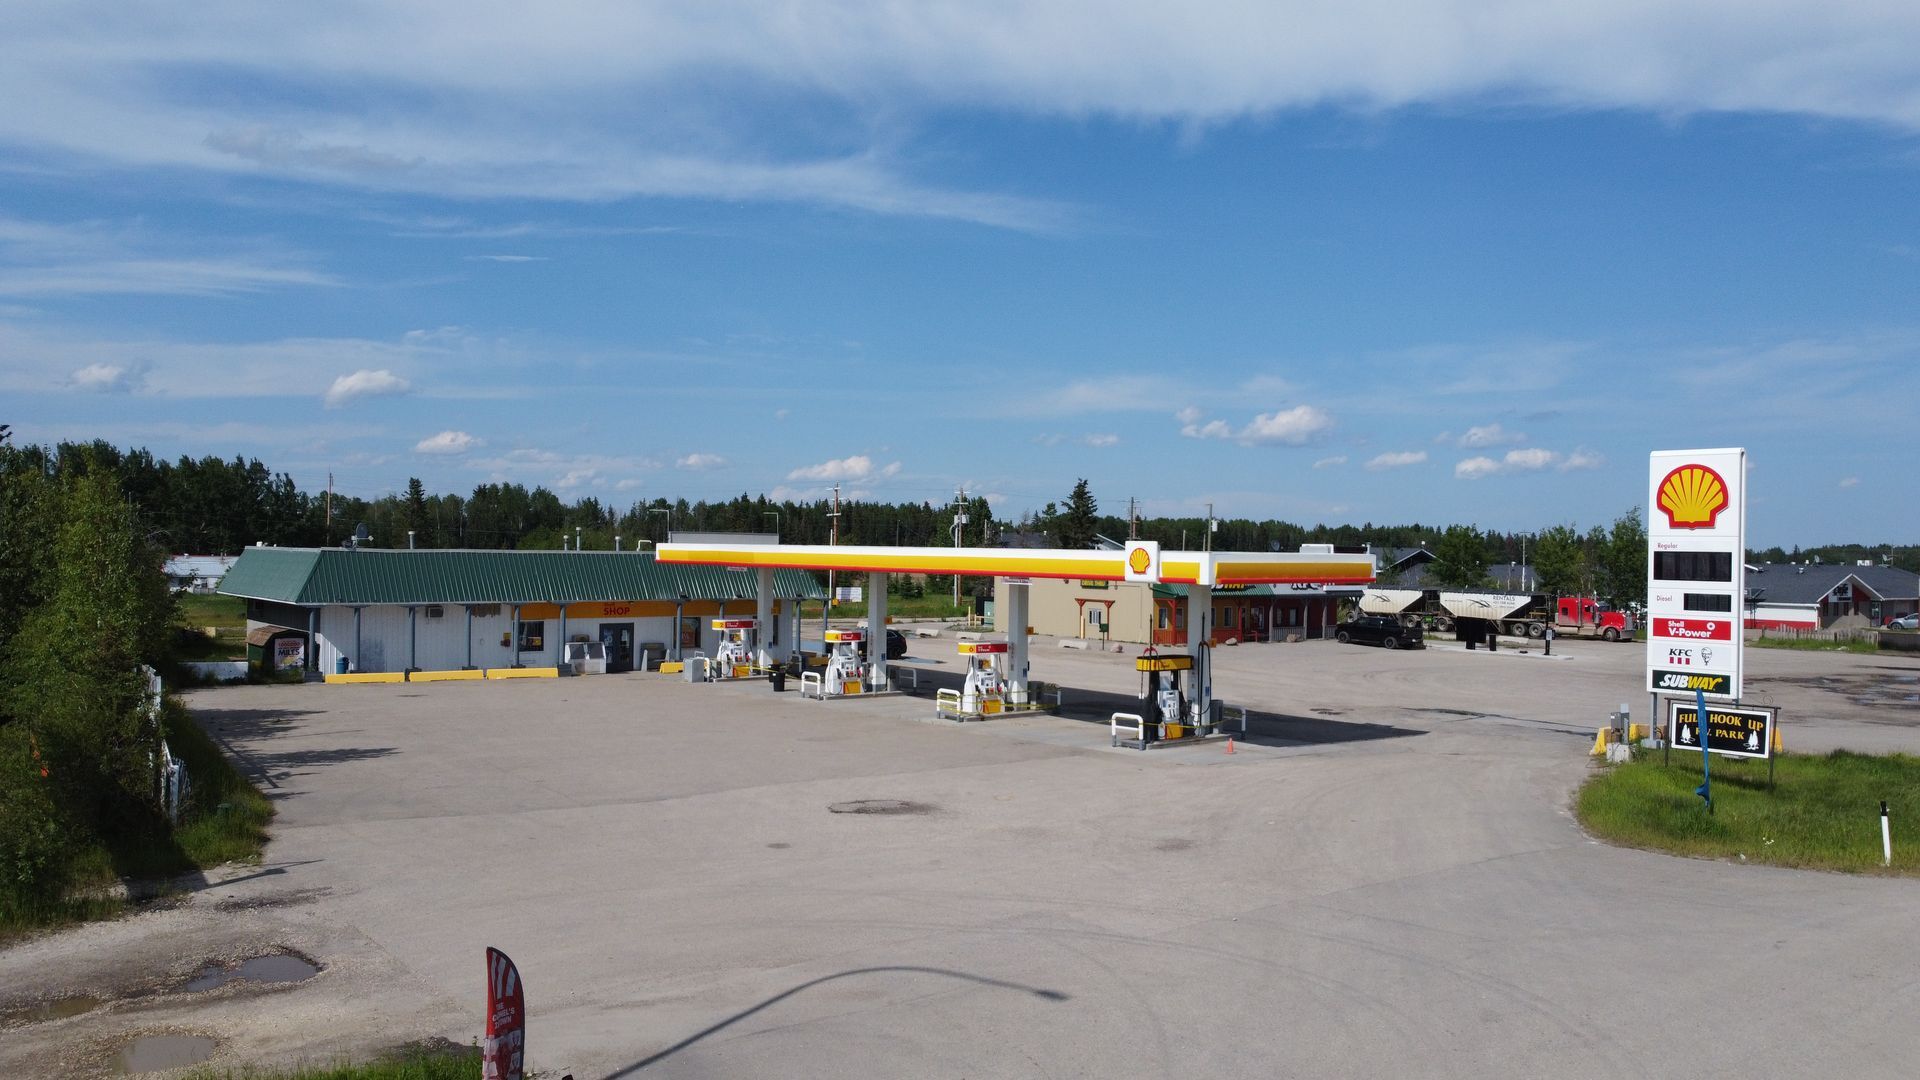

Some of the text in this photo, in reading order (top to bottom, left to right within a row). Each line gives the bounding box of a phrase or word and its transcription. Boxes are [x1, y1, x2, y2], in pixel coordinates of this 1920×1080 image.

[604, 607, 630, 615] SHOP
[1668, 620, 1685, 628] Shell
[1668, 627, 1712, 638] V-Power
[278, 648, 300, 656] MILES
[1669, 648, 1693, 657] KFC
[1659, 674, 1723, 690] SUBWAY
[1679, 713, 1764, 731] FUL HOOK UP
[1715, 729, 1744, 740] PARK
